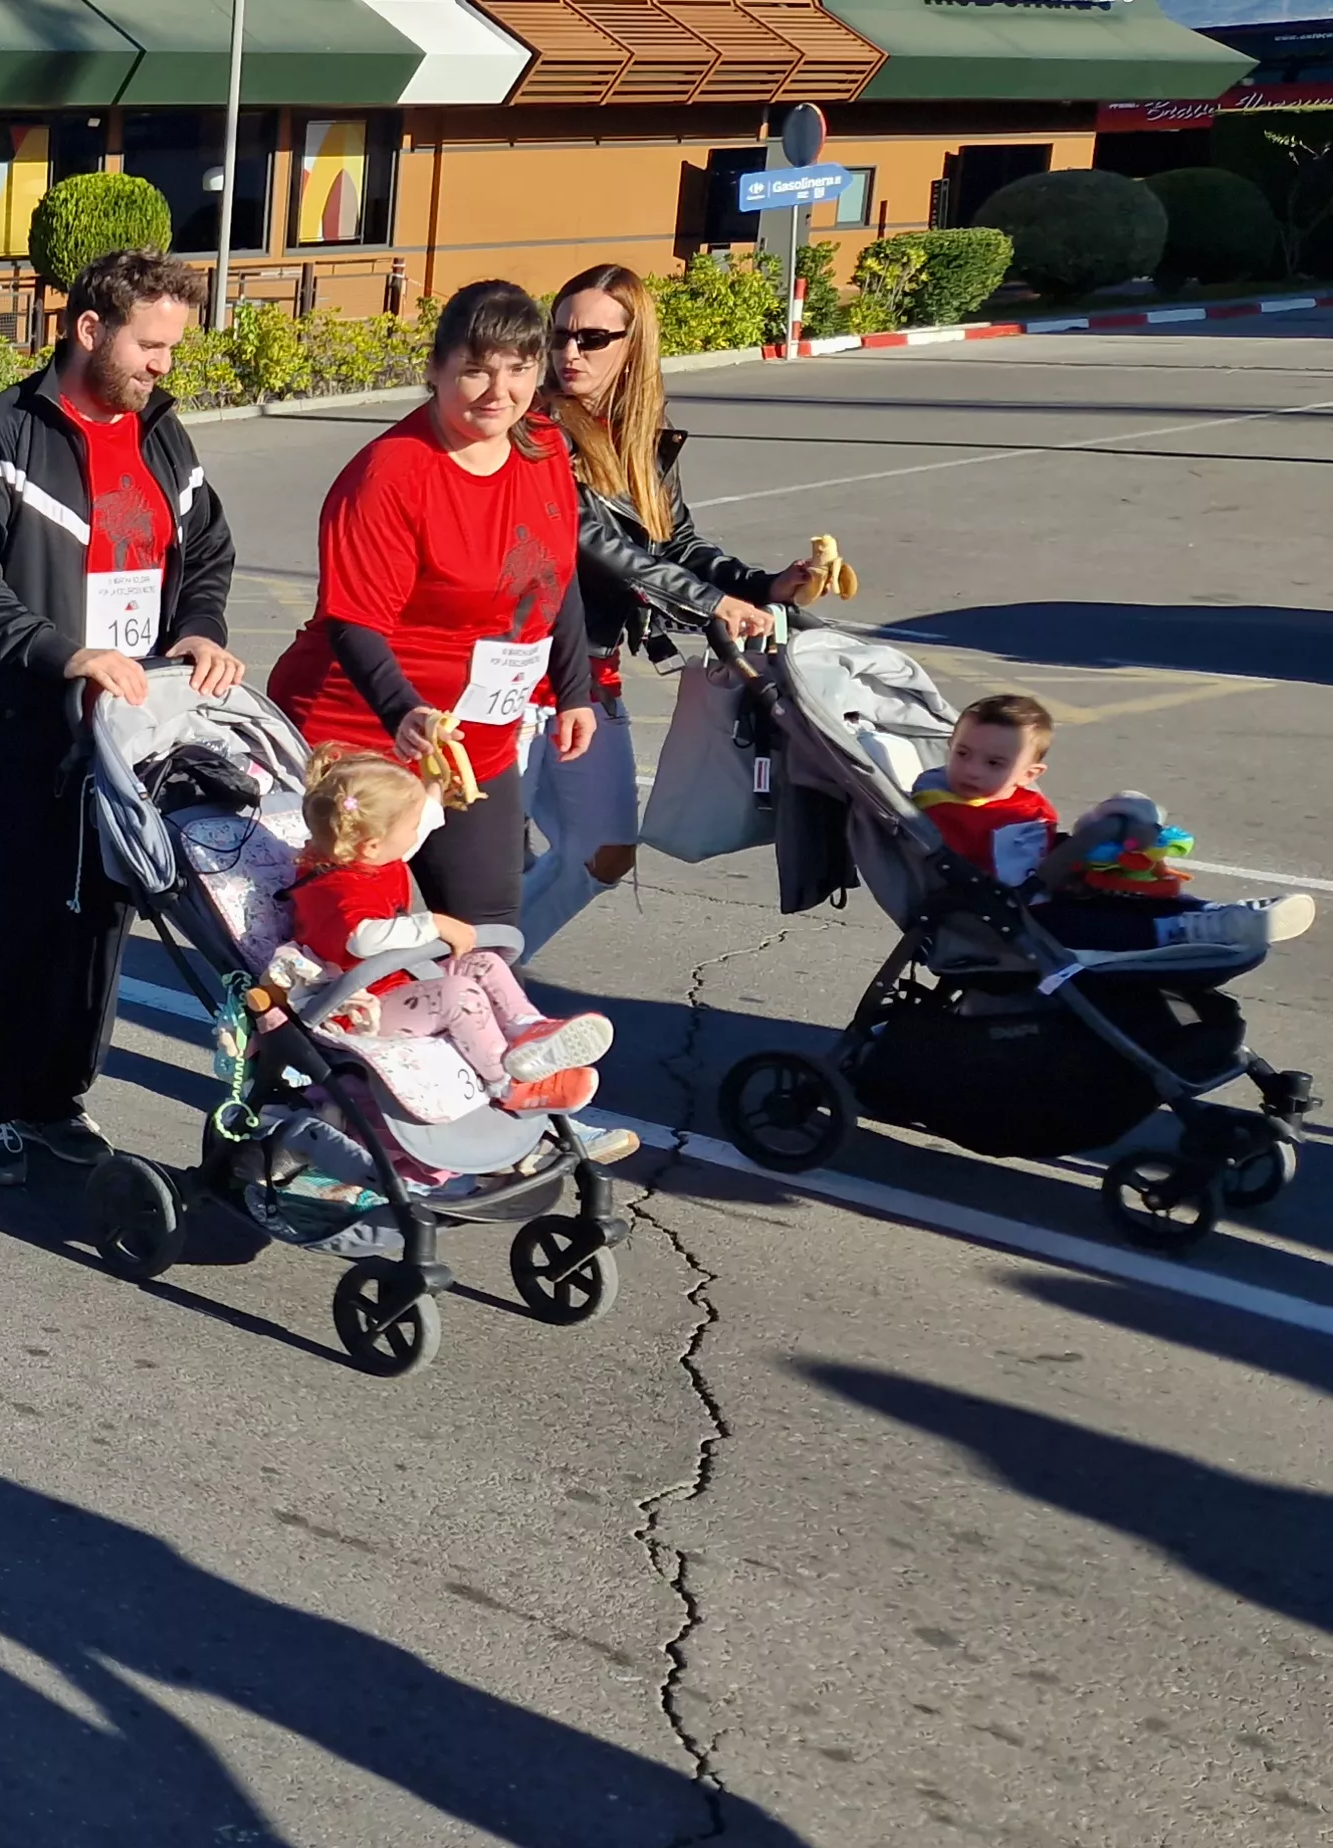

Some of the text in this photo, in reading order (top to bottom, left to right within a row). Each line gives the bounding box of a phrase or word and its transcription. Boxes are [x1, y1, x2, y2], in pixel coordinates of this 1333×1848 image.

[772, 176, 834, 193] Gasolinera
[108, 617, 151, 647] 164
[487, 687, 529, 715] 165
